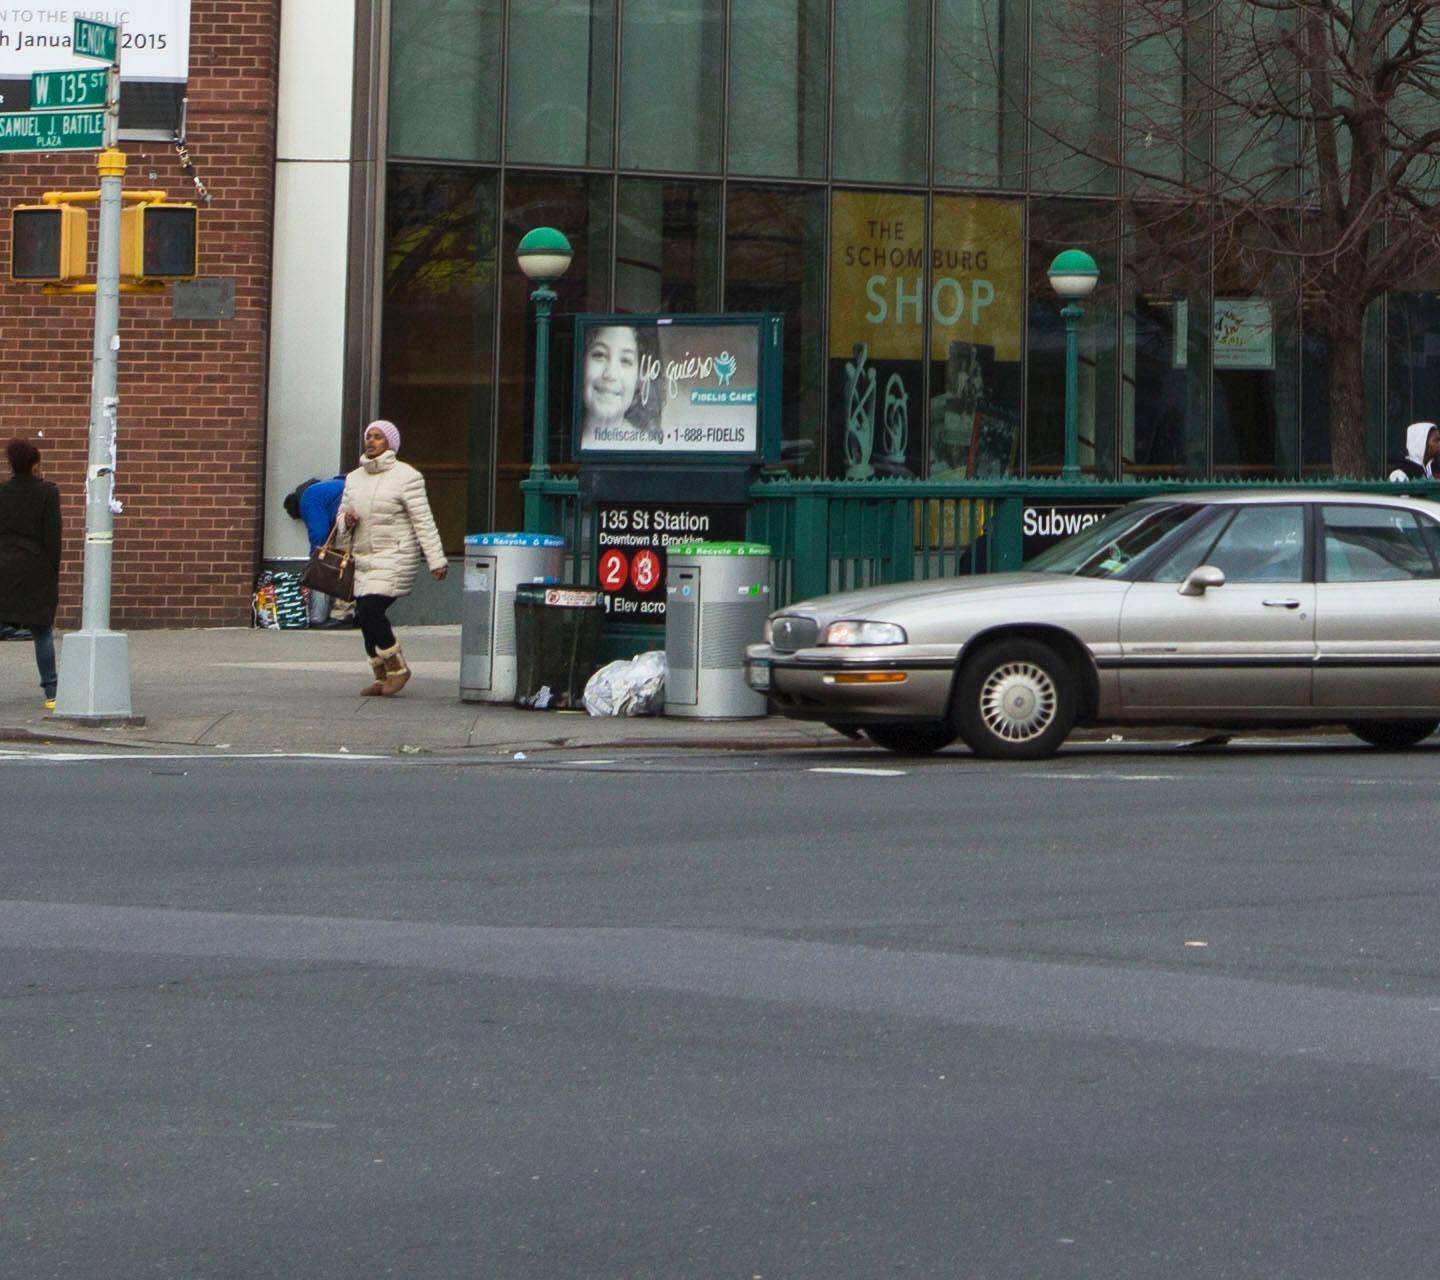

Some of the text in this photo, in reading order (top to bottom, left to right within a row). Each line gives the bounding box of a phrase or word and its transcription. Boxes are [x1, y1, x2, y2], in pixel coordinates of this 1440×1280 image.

[12, 10, 34, 23] TO
[38, 10, 67, 23] THE
[16, 30, 72, 51] Janua
[121, 33, 167, 50] 2015
[75, 22, 106, 56] LENOX
[35, 72, 105, 104] W 135 ST
[47, 117, 57, 135] J.
[62, 114, 102, 135] BATTLE
[36, 136, 62, 147] PLAZA
[867, 220, 904, 240] THE
[846, 246, 988, 271] SCHOMBURG
[864, 274, 995, 326] SHOP
[639, 351, 713, 406] Yo quiero
[691, 391, 753, 402] FIDELIS CARE
[594, 427, 745, 445] fideliscare.org 1-888-FIDELIS
[600, 510, 709, 531] 135 St Station
[599, 533, 649, 545] Downtown
[652, 534, 659, 546] &
[696, 547, 731, 555] Recycle
[607, 556, 621, 583] 2
[638, 557, 653, 585] 3
[614, 597, 637, 612] Elev
[640, 599, 666, 614] acro
